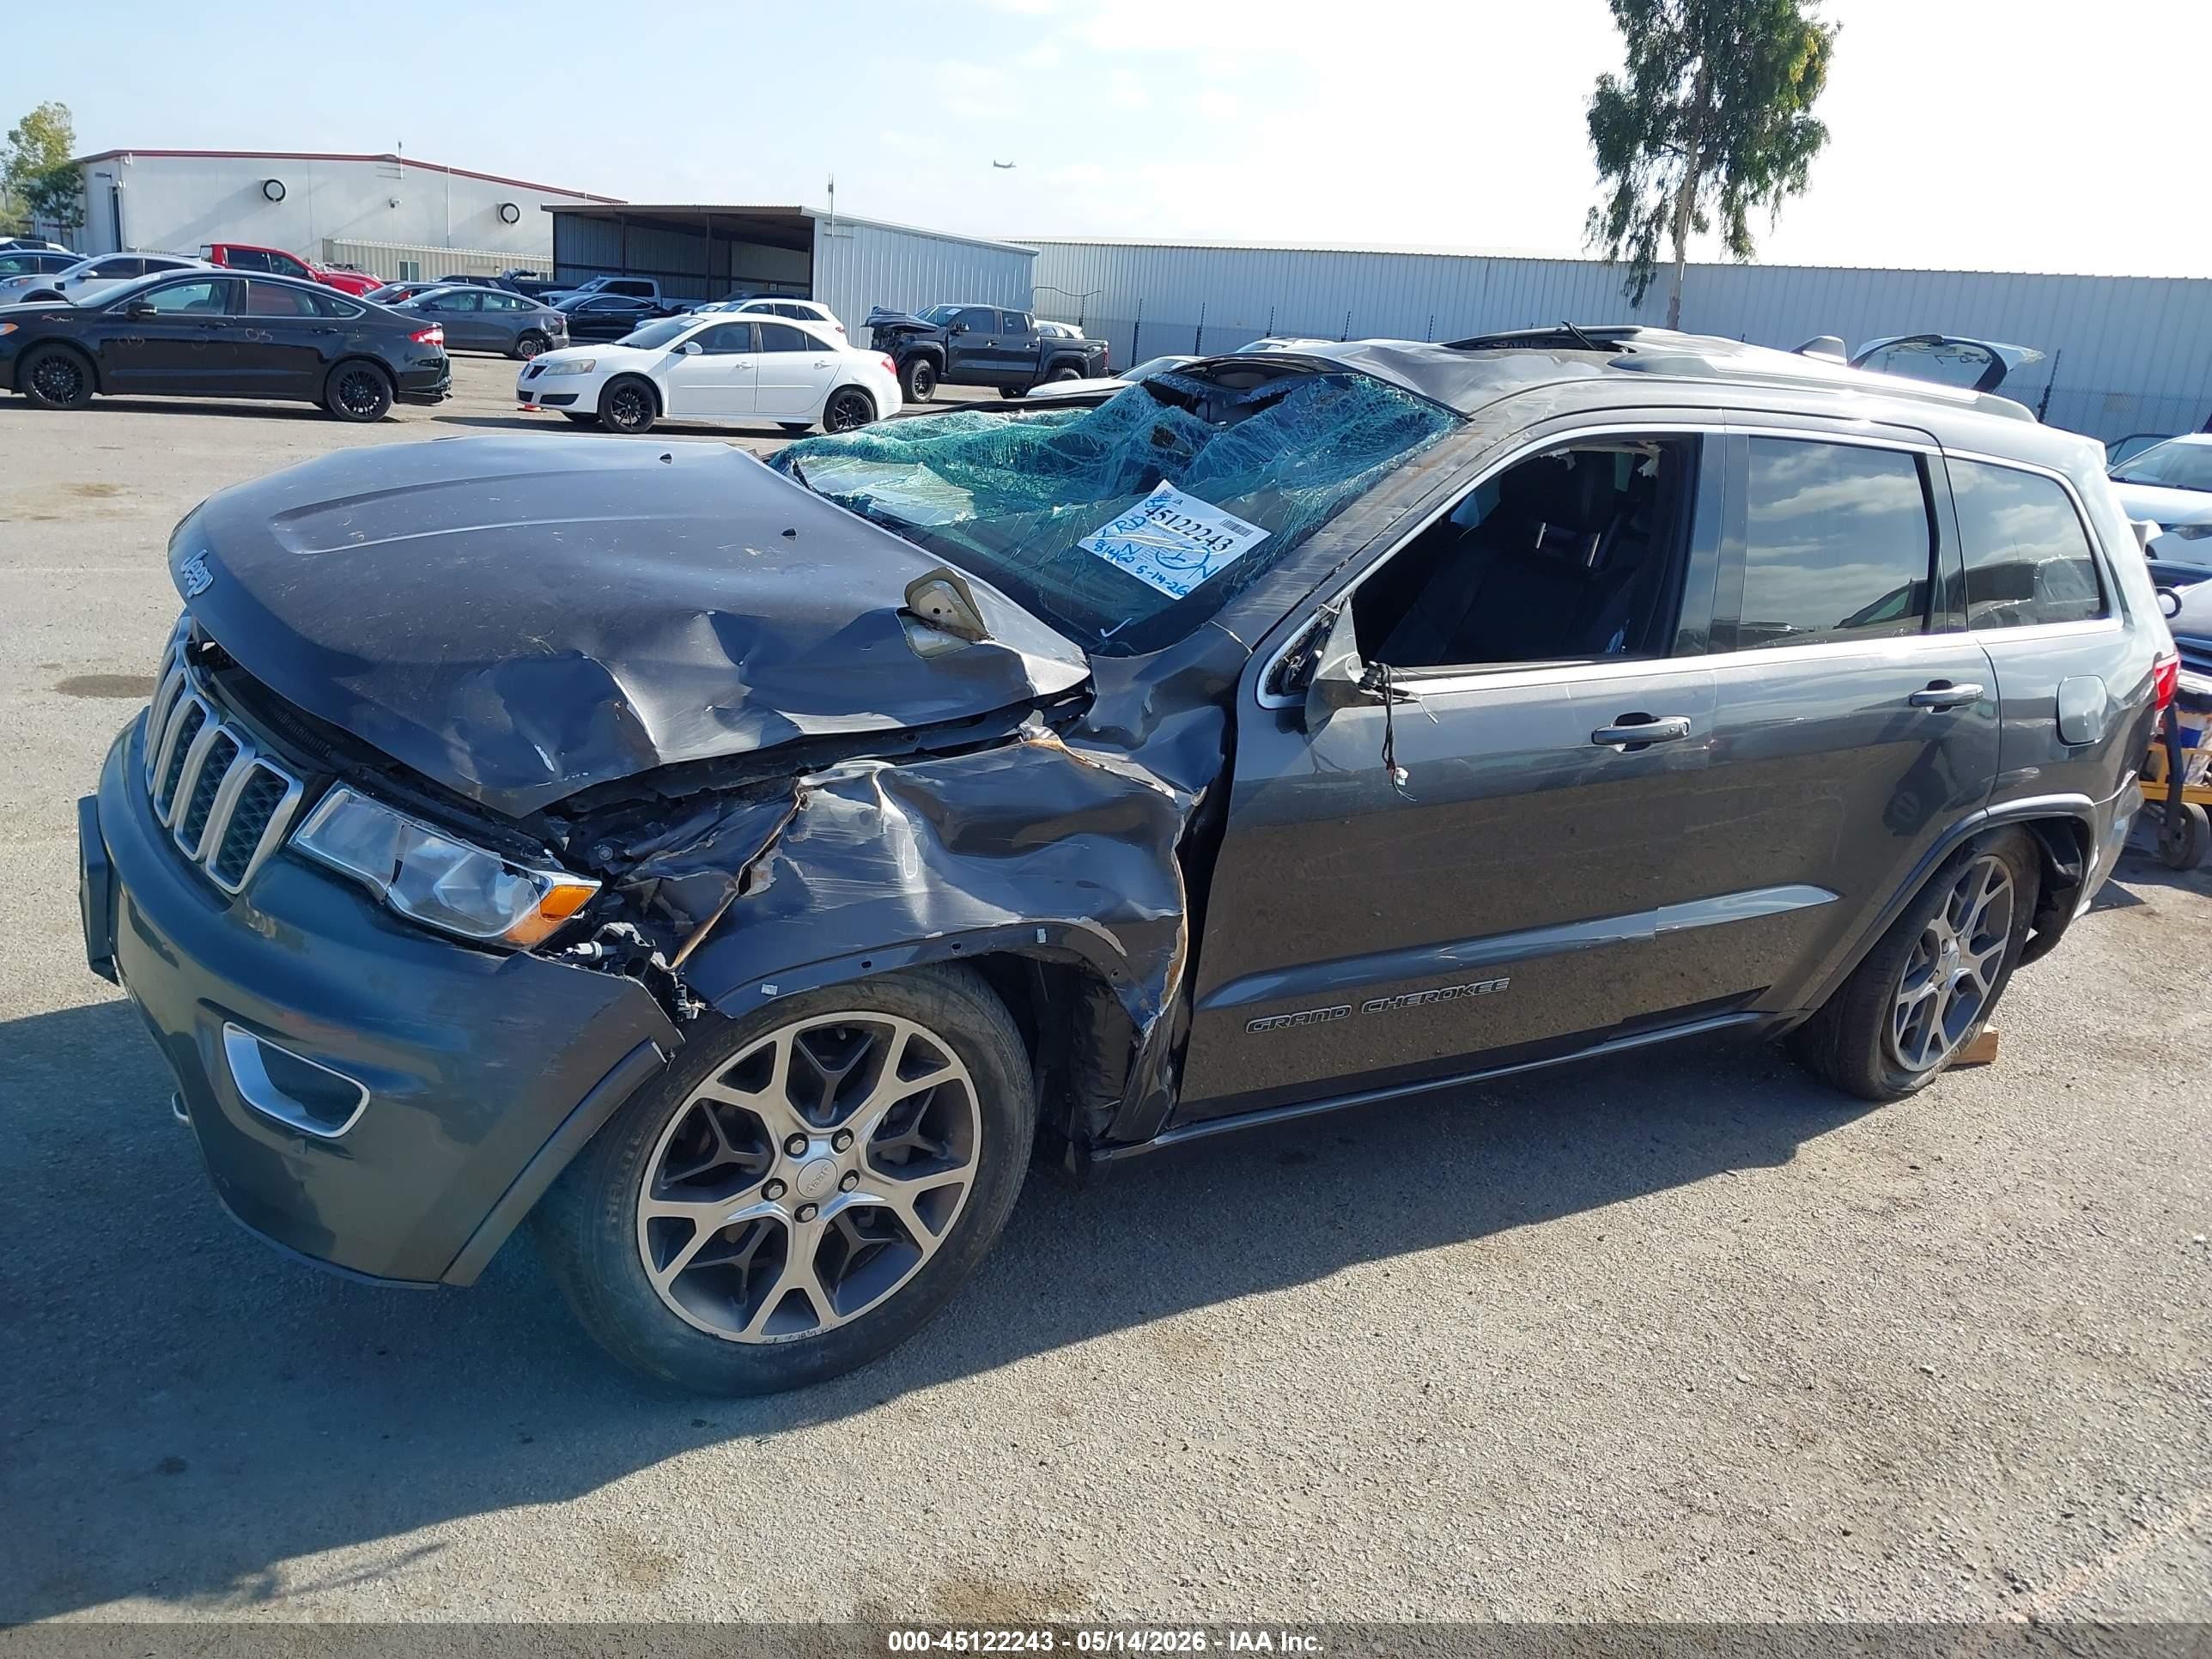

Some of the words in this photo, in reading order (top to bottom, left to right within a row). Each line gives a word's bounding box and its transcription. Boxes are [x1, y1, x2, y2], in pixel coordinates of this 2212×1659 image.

[1145, 506, 1235, 552] 45122243
[179, 549, 214, 599] Jeep
[1135, 565, 1191, 595] 5-14-26
[1245, 1004, 1352, 1034] GRAND
[1360, 977, 1511, 1015] CHEROKEE
